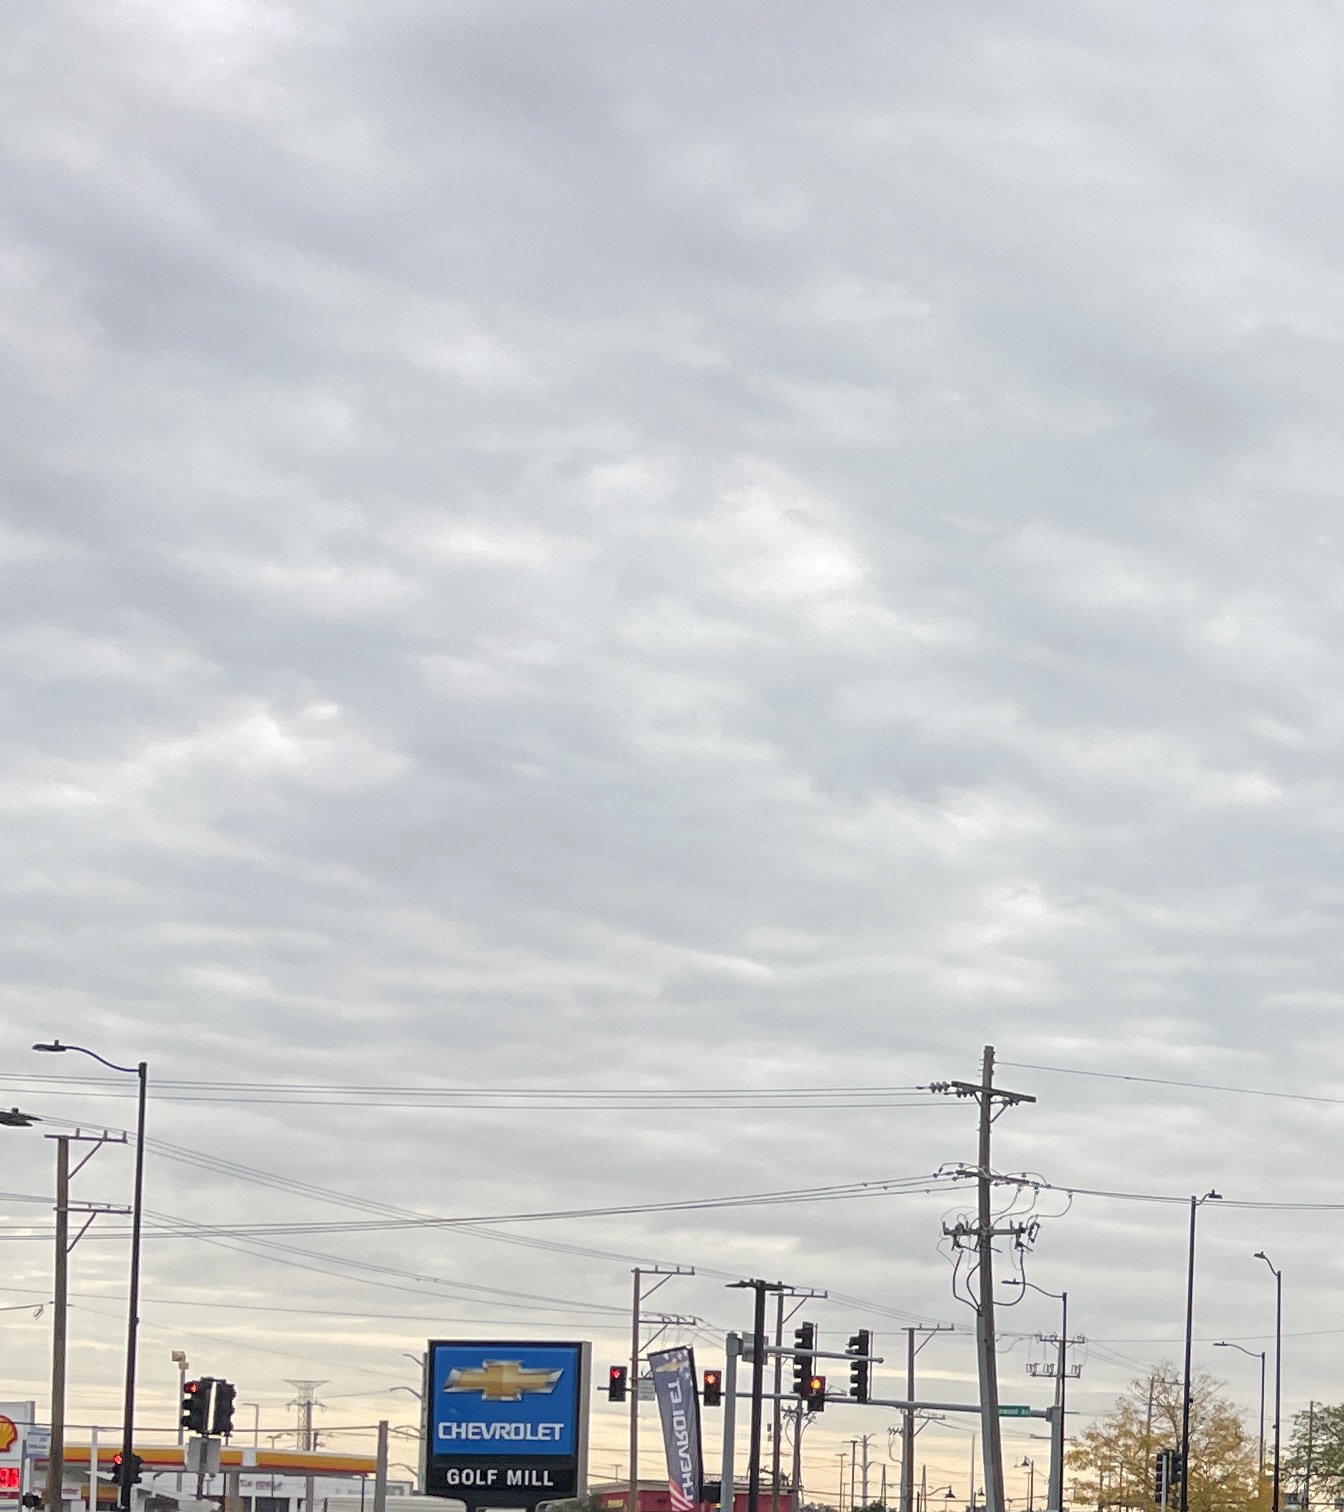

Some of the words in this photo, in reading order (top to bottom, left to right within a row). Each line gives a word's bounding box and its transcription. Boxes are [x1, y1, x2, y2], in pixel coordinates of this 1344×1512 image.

[438, 1421, 565, 1441] CHEVROLET
[446, 1468, 498, 1486] GOLF
[506, 1469, 554, 1487] MILL
